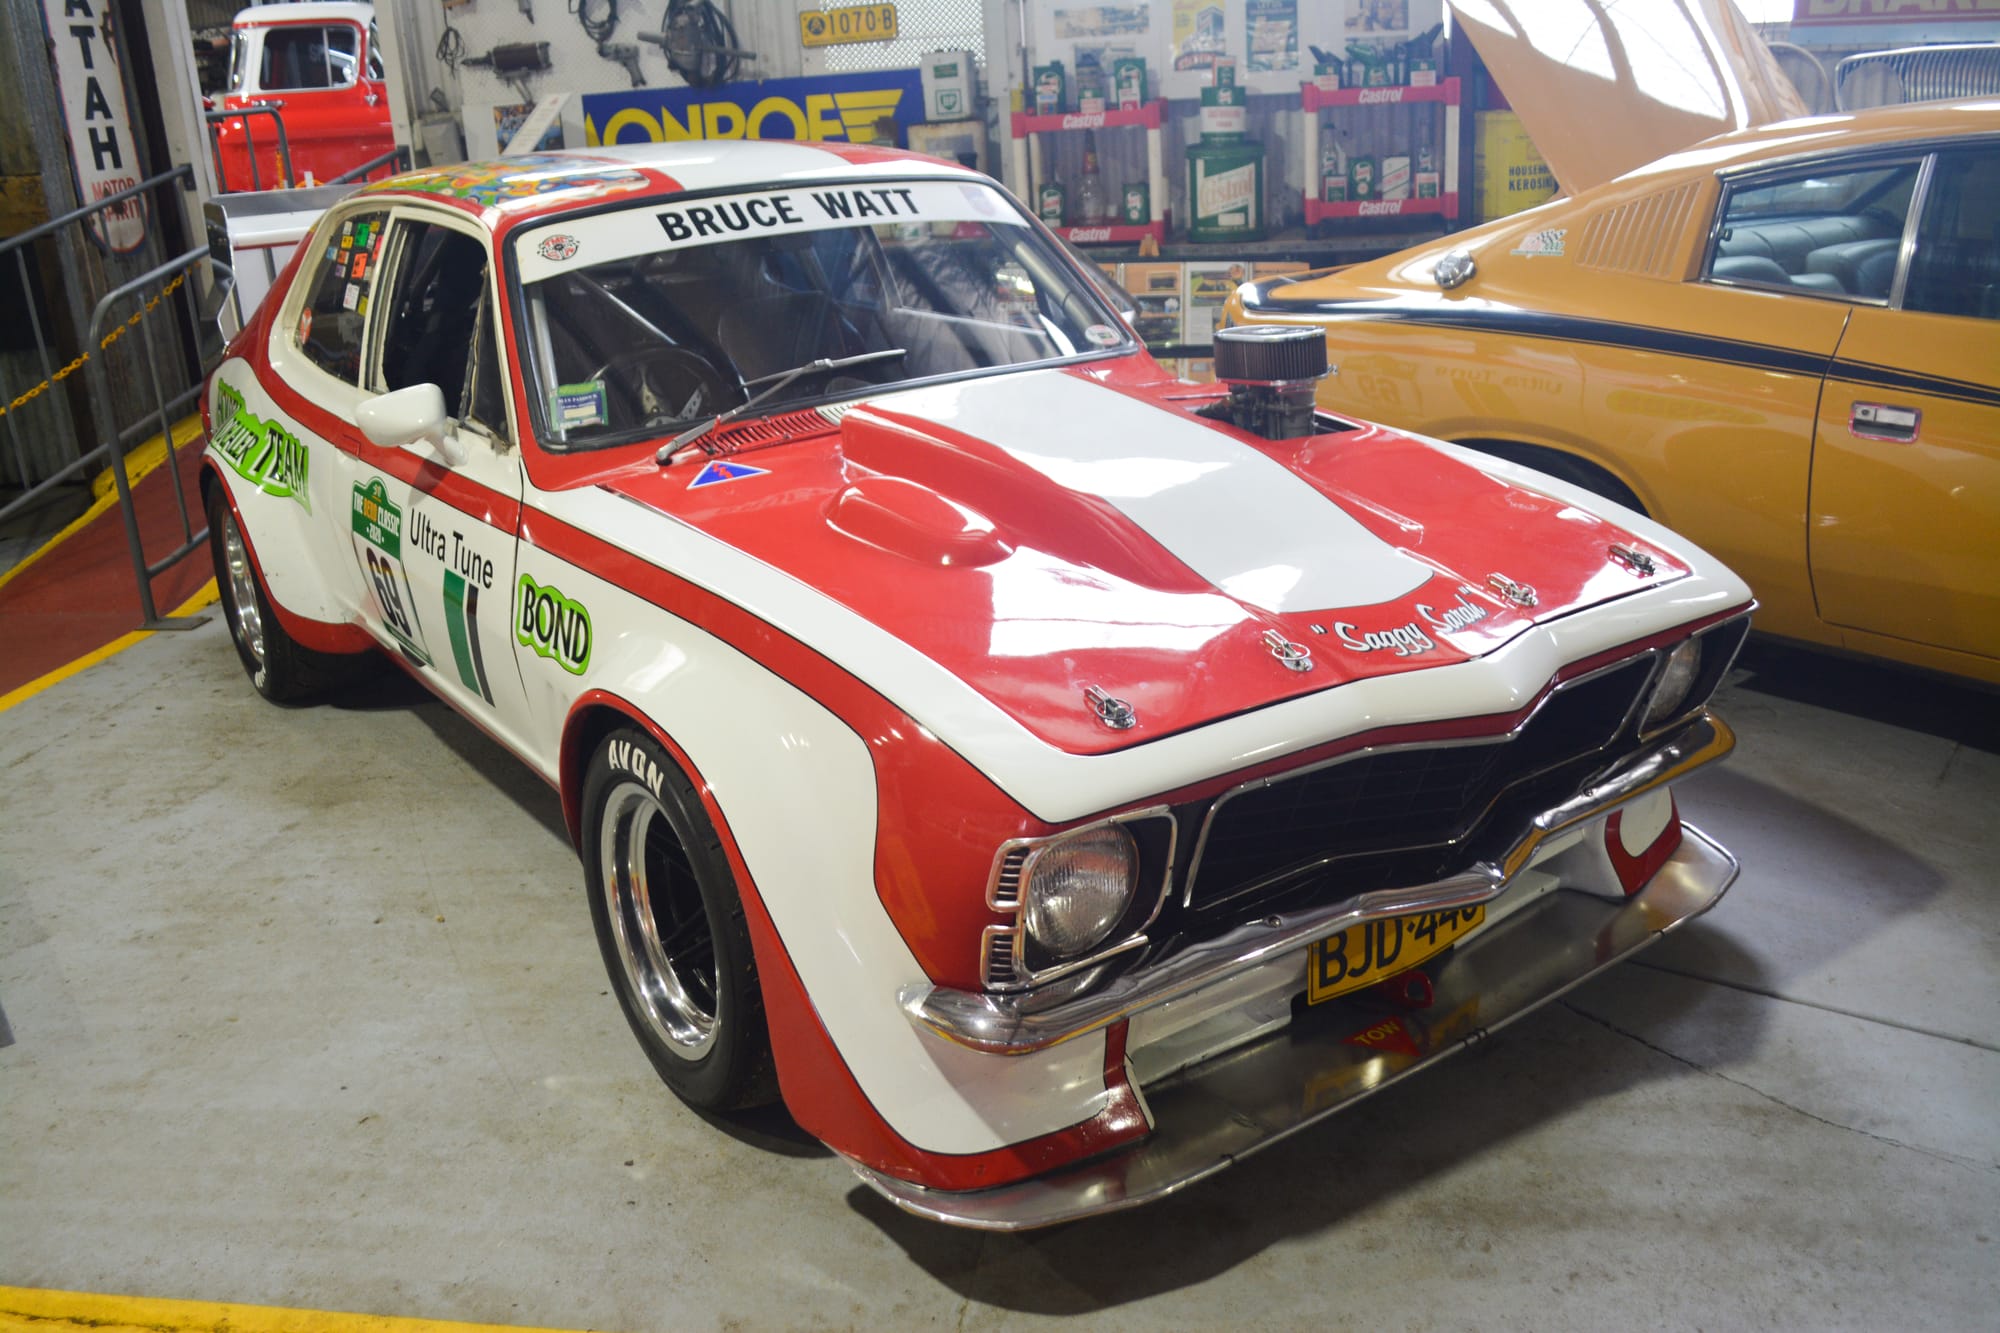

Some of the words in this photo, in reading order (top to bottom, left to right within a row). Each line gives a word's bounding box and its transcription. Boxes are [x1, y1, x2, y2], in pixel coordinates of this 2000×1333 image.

[1358, 88, 1403, 104] Castrol
[1062, 113, 1106, 130] Castrol
[656, 195, 804, 242] BRUCE
[811, 188, 920, 219] WATT
[1358, 200, 1402, 216] Castrol
[1069, 227, 1112, 242] Castrol
[248, 427, 306, 498] TEAM
[353, 491, 364, 514] THE
[377, 507, 400, 537] CLASSIC
[410, 507, 446, 562] Ultra
[452, 530, 494, 590] Tune
[366, 547, 412, 638] 69
[521, 583, 590, 665] BOND
[608, 739, 664, 801] AVON
[1354, 1021, 1400, 1046] TOW
